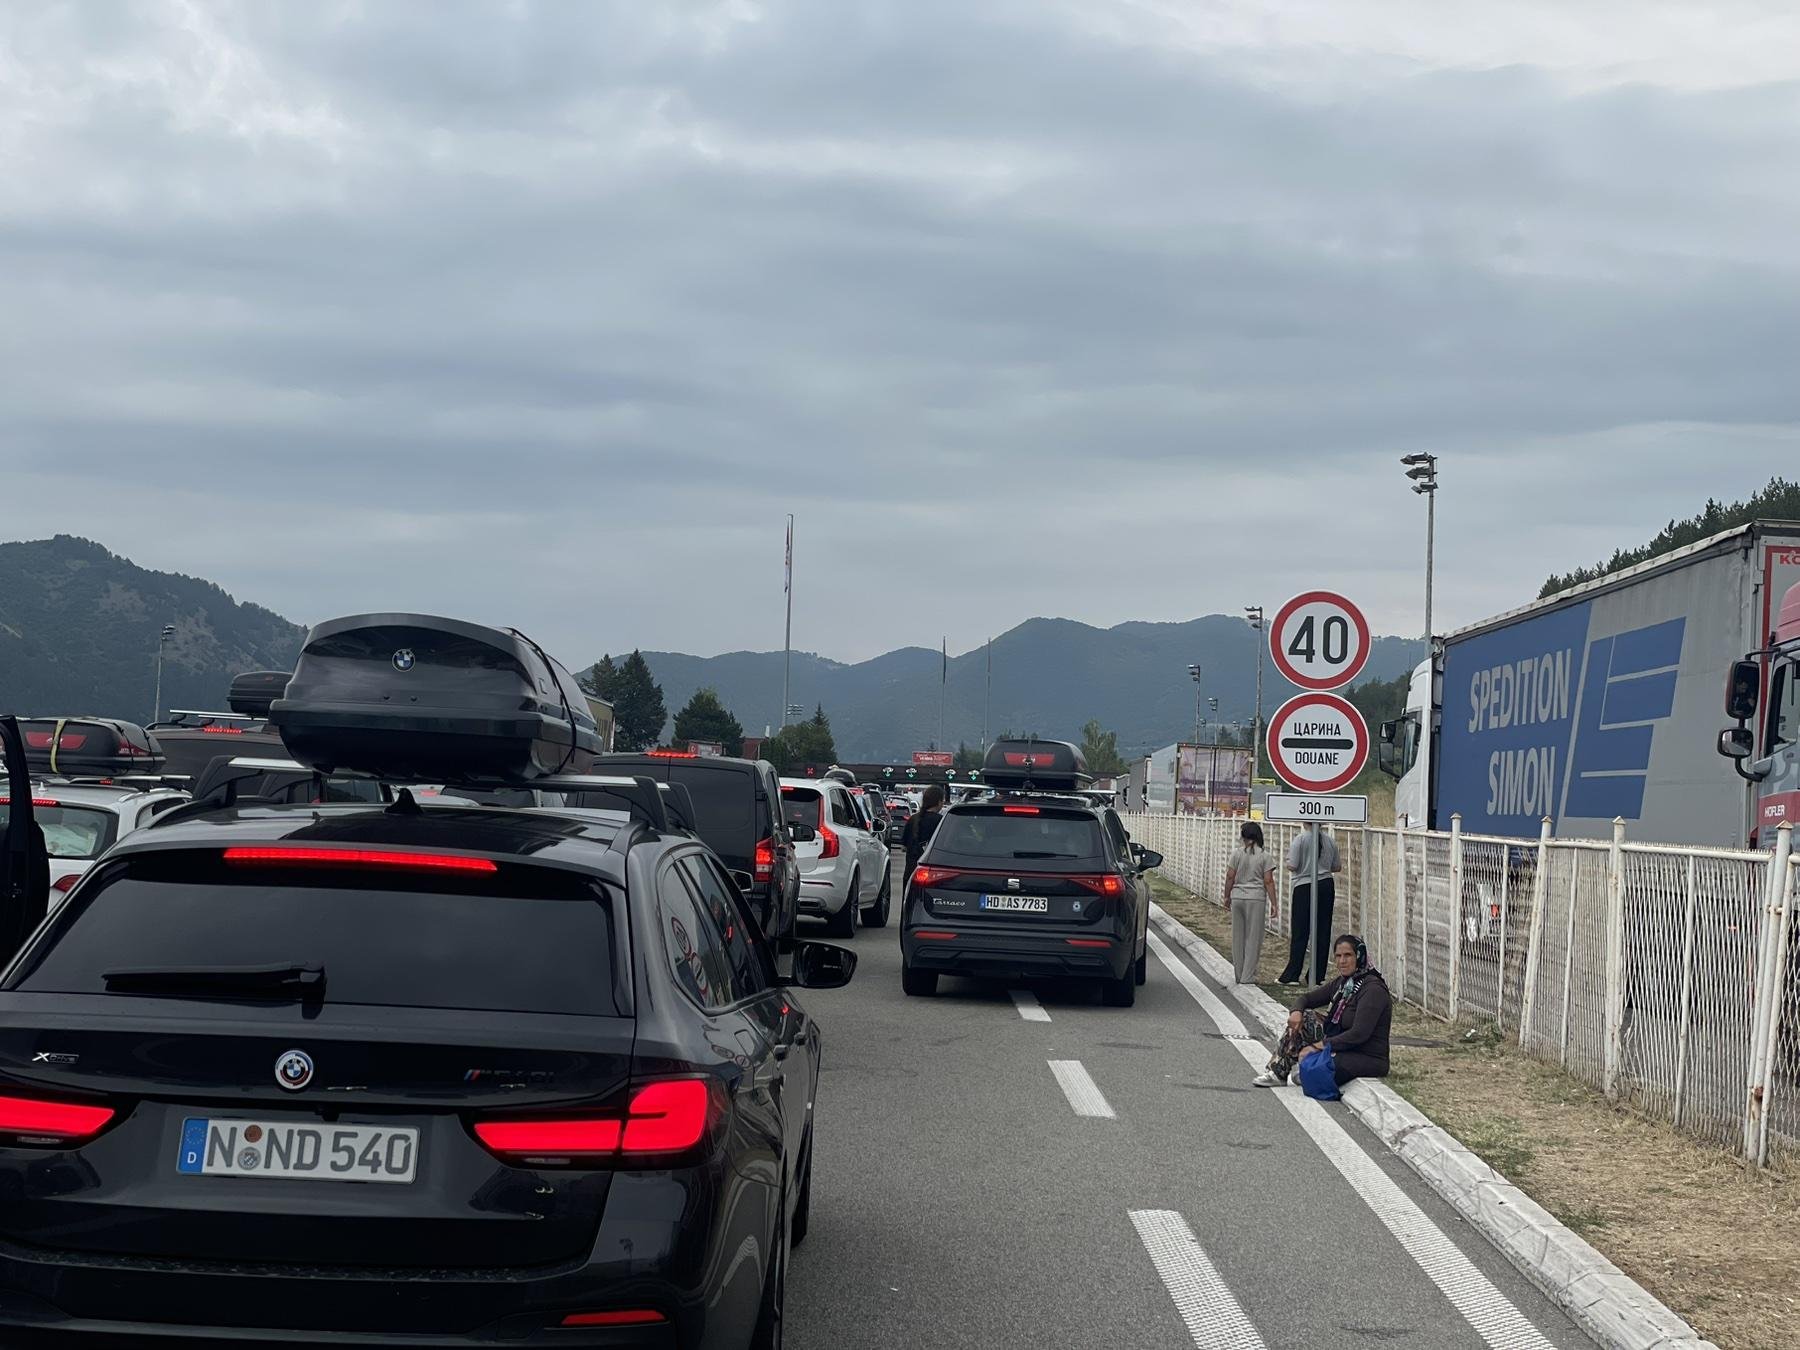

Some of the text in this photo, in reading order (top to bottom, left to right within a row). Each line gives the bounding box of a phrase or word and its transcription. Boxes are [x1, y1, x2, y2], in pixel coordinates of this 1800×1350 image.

[1288, 615, 1348, 664] 40
[1468, 648, 1571, 733] SPEDITION
[1294, 722, 1341, 736] ЦАРИНА
[1295, 752, 1339, 765] DOUANE
[1486, 746, 1556, 816] SIMON
[1299, 801, 1335, 815] 300 m
[986, 896, 999, 908] HD
[1006, 897, 1020, 909] AS
[1022, 898, 1047, 910] 7783
[187, 1151, 197, 1164] D
[206, 1126, 412, 1175] N ND 540
